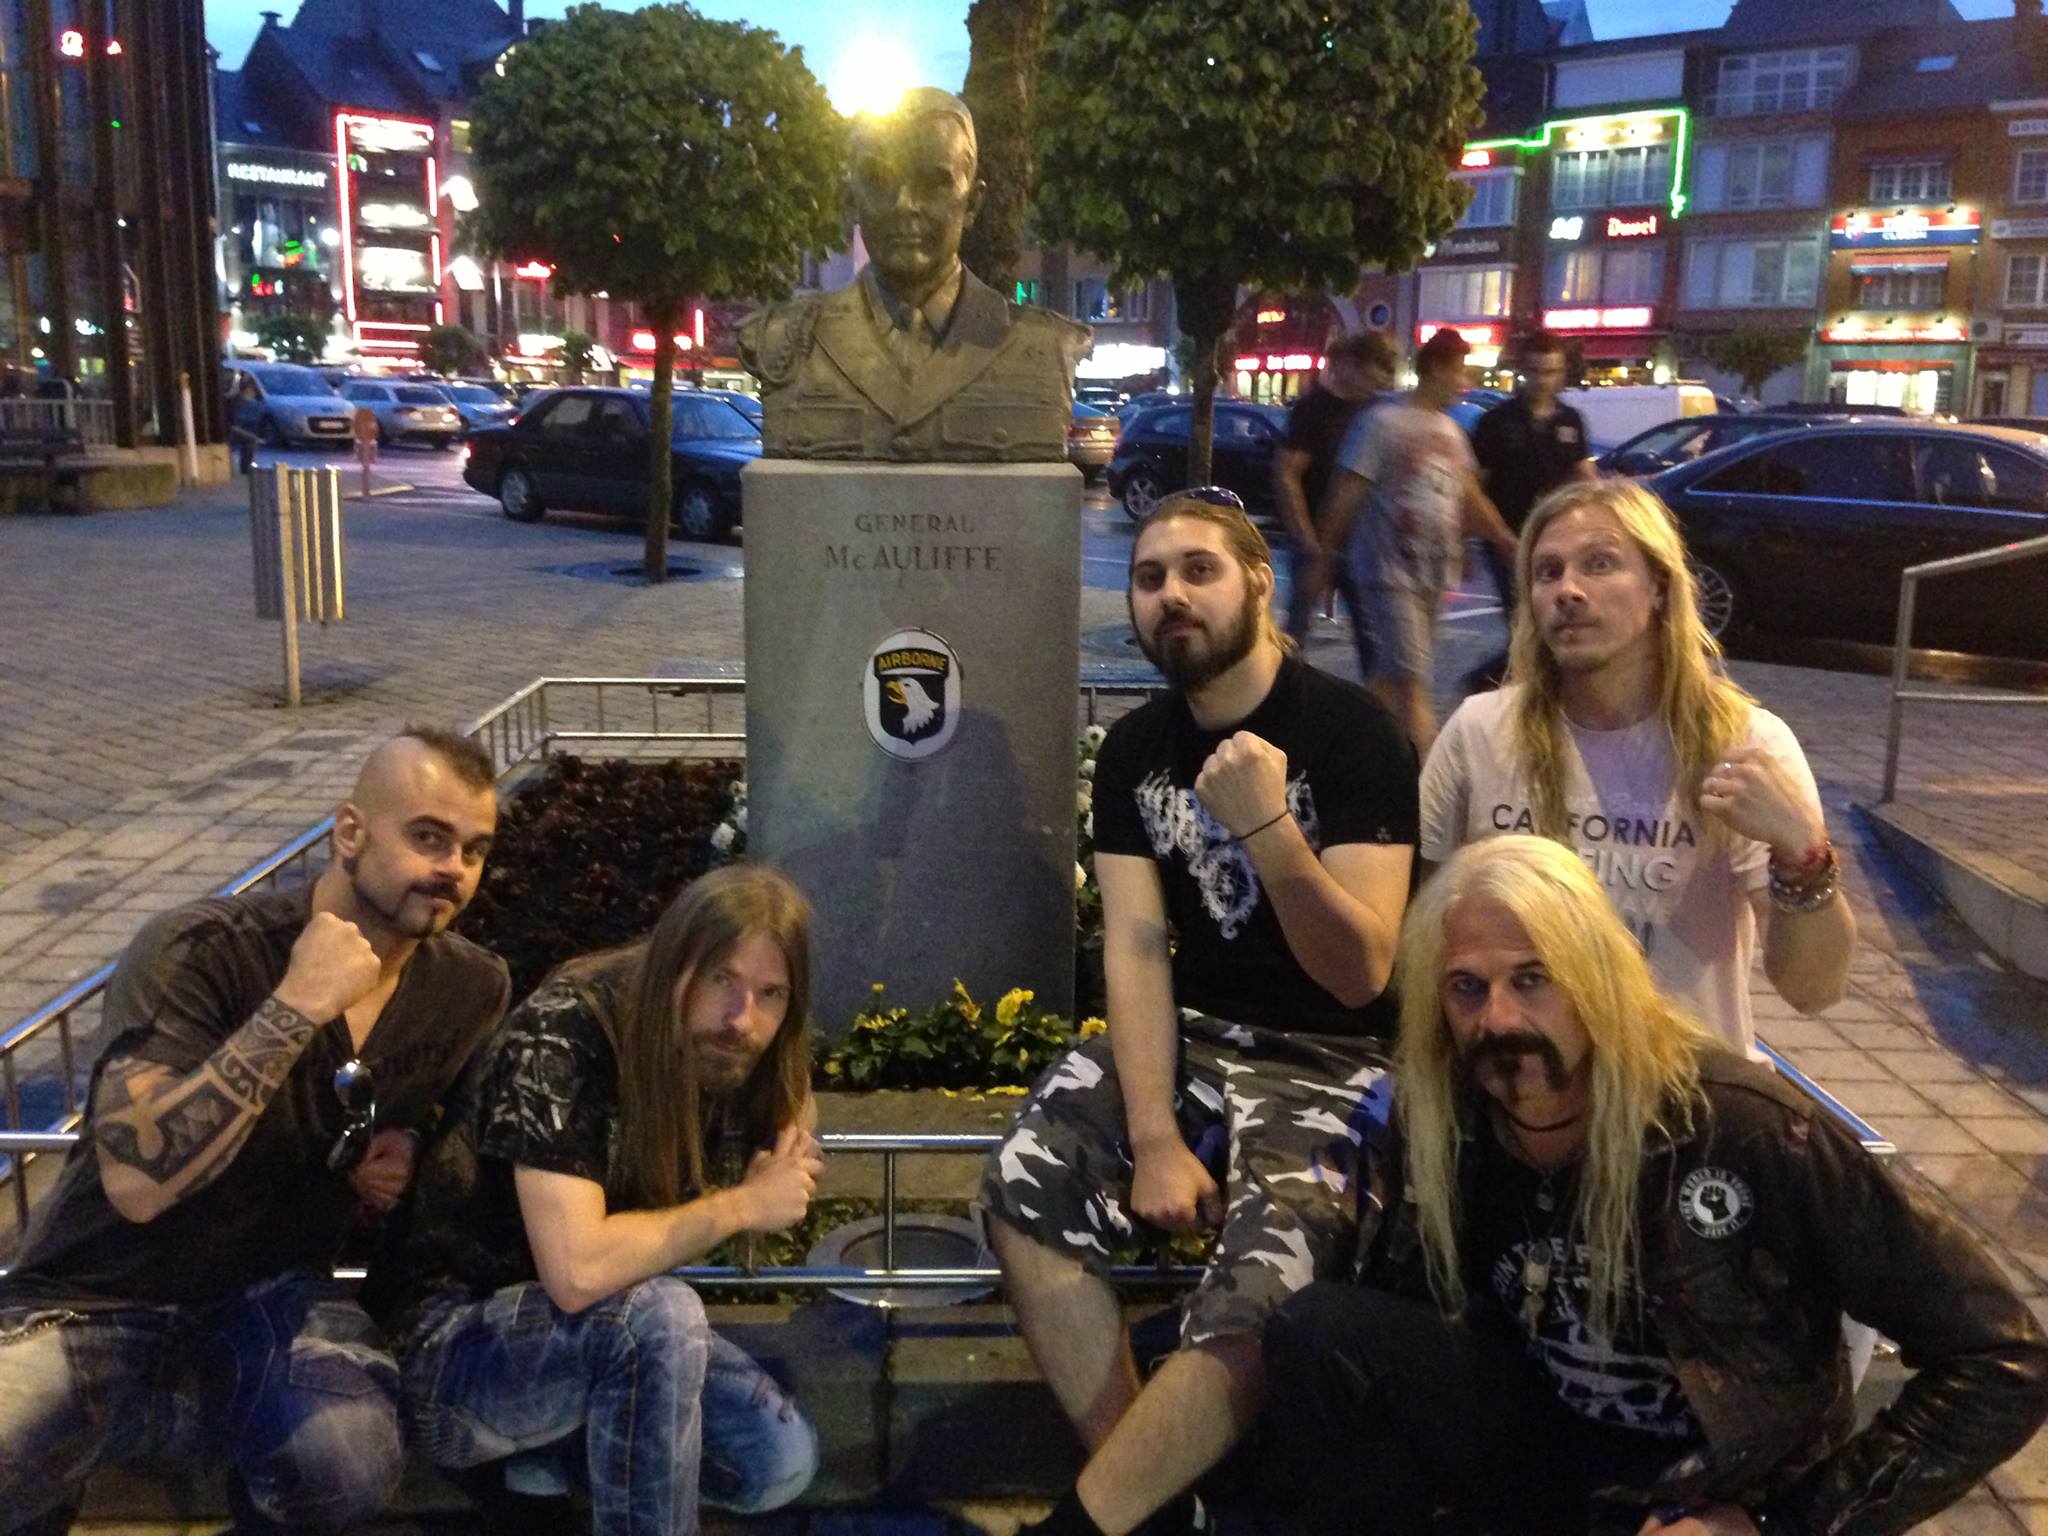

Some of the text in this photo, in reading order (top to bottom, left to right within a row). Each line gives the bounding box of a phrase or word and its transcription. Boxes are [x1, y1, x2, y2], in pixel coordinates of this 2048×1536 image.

[1607, 216, 1657, 237] Duvel
[854, 513, 975, 534] GENERAL
[879, 651, 946, 671] AIRBORNE
[1492, 804, 1696, 848] CAFORNIA
